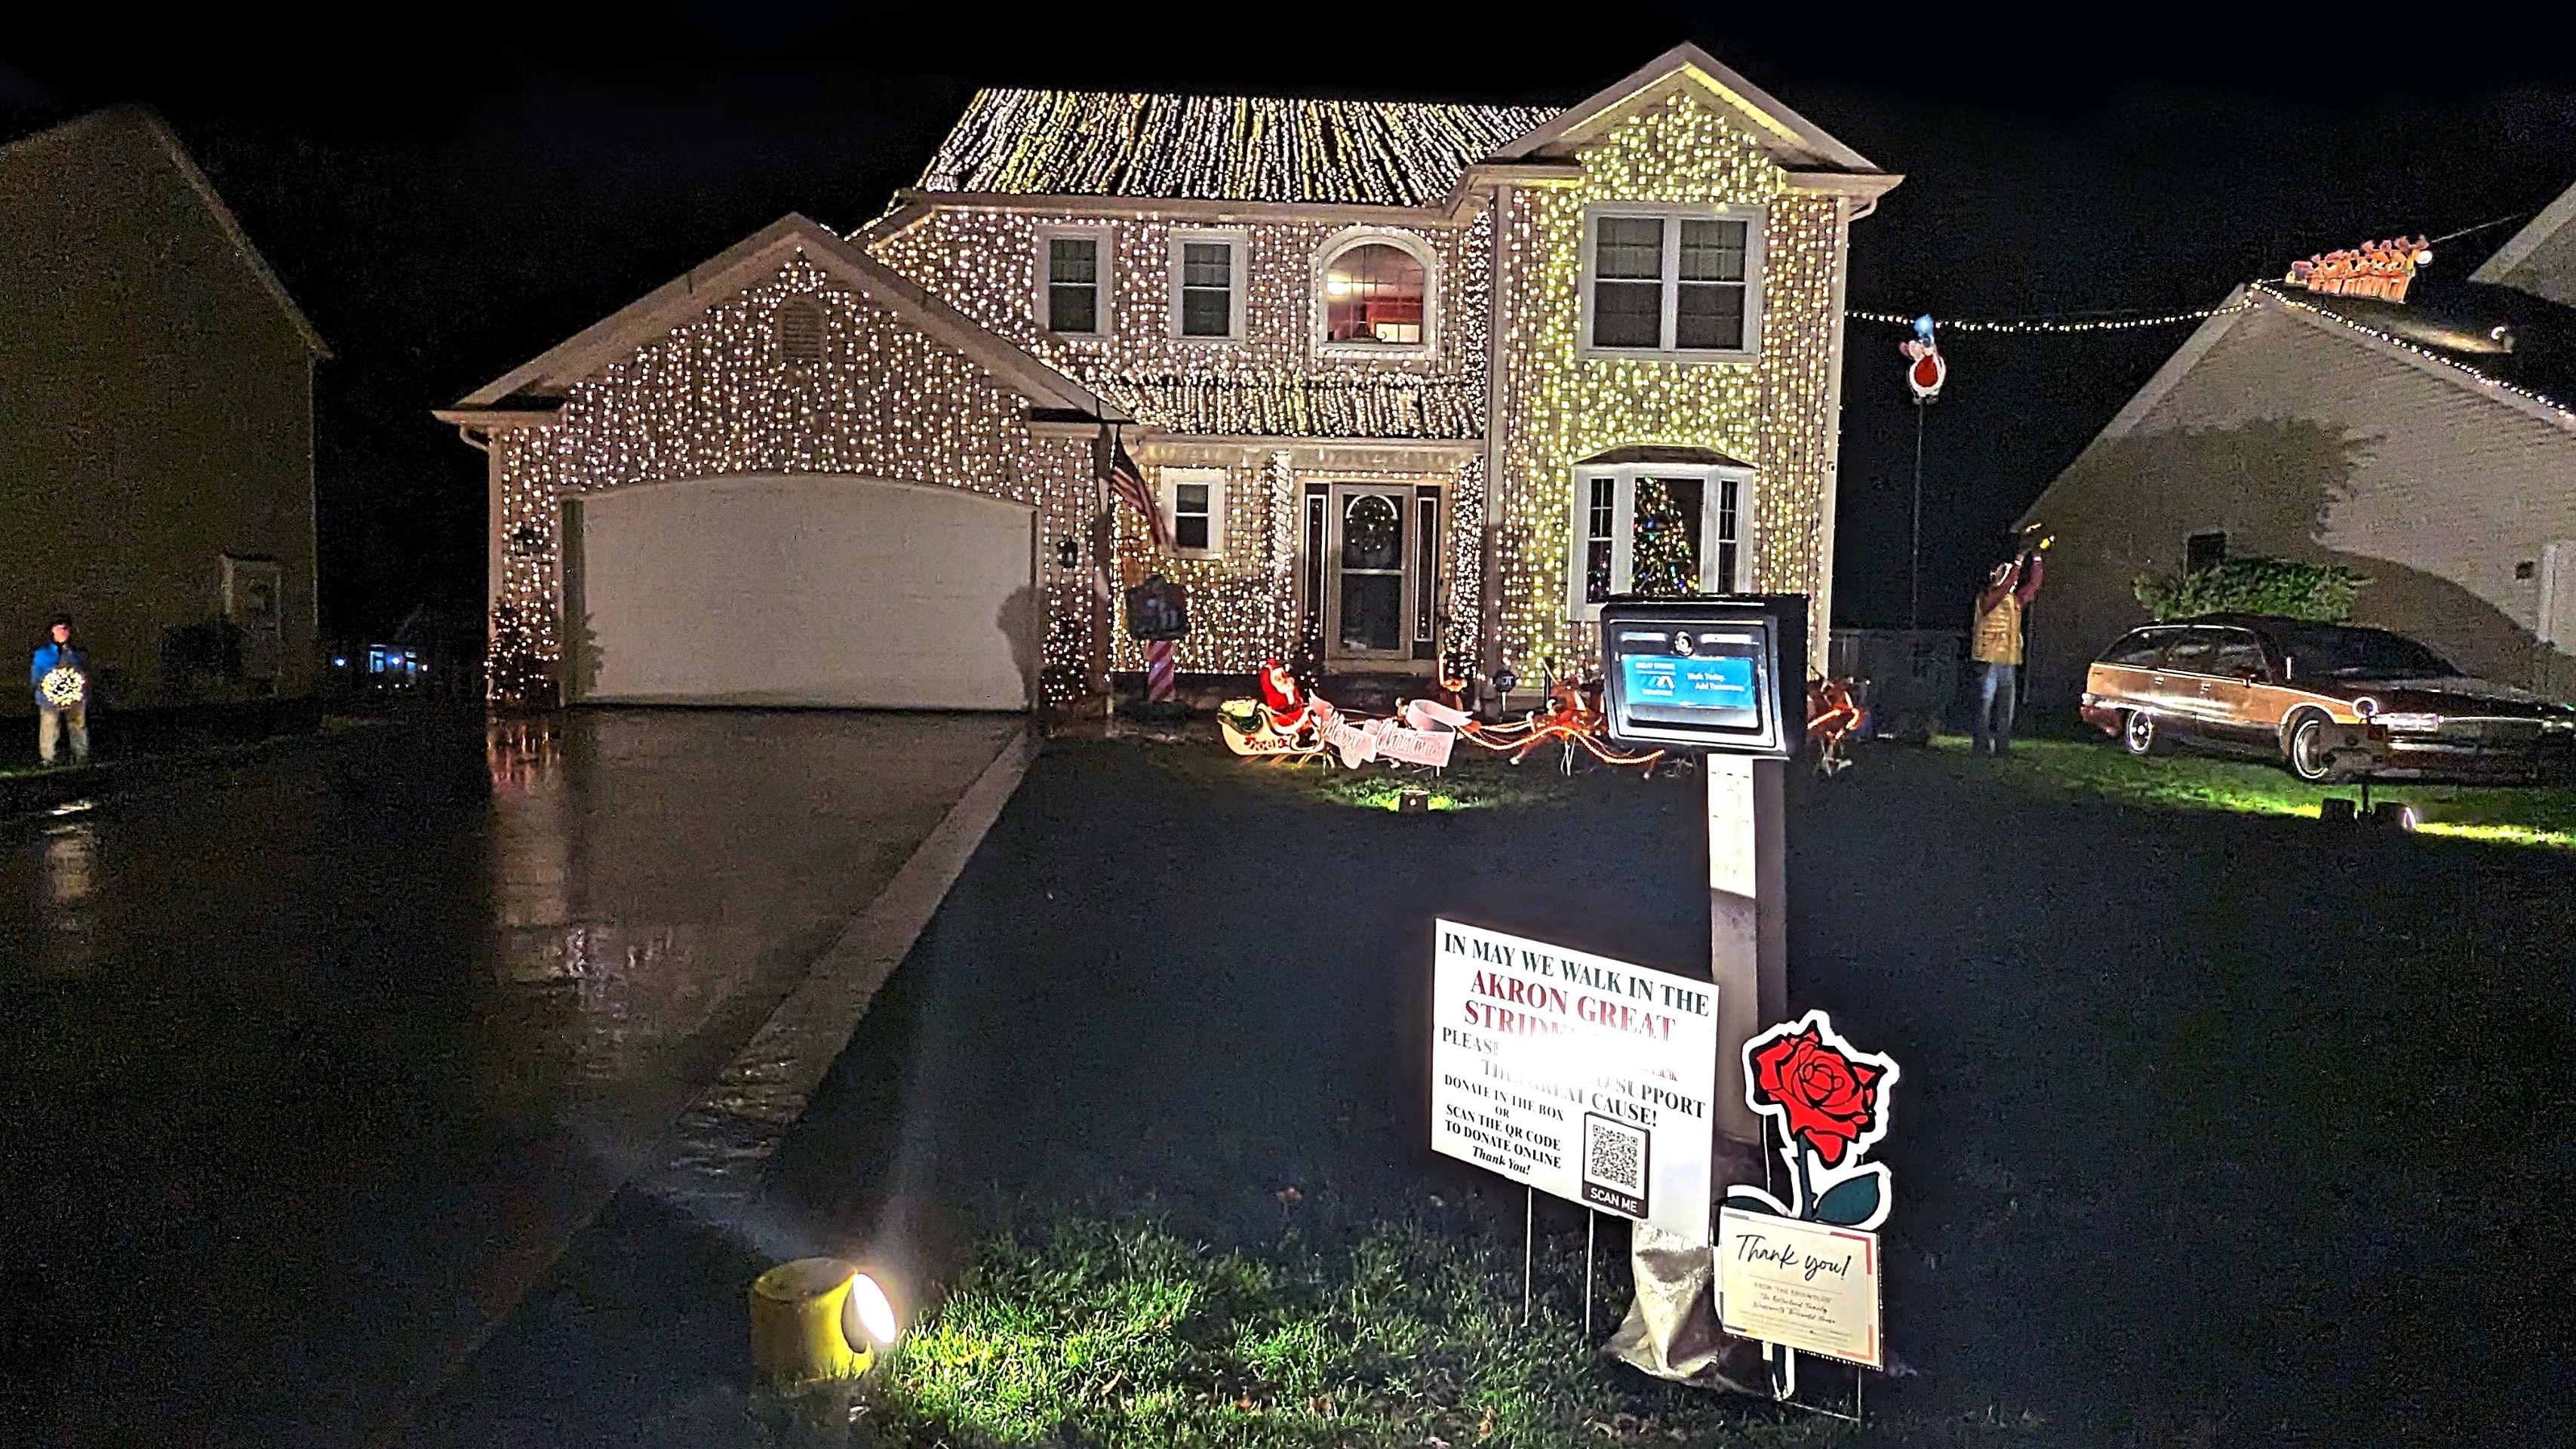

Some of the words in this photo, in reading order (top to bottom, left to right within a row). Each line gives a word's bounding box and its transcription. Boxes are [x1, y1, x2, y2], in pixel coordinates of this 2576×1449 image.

[1320, 711, 1366, 763] Merry
[1376, 718, 1446, 759] Christmas
[1444, 932, 1466, 955] IN
[1472, 939, 1516, 967] MAY
[1521, 950, 1554, 977] WE
[1560, 959, 1622, 994] WALK
[1628, 977, 1653, 1001] IN
[1660, 984, 1709, 1017] THE
[1471, 970, 1569, 1014] AKRON
[1577, 995, 1676, 1041] GREAT
[1444, 1074, 1490, 1098] DONATE
[1495, 1090, 1507, 1103] IN
[1511, 1094, 1535, 1112] THE
[1539, 1104, 1563, 1121] BOX
[1495, 1106, 1510, 1118] OR
[1591, 1093, 1657, 1127] CAUSE!
[1615, 1078, 1705, 1118] SUPPORT
[1445, 1119, 1461, 1134] TO
[1464, 1126, 1511, 1152] DONATE
[1514, 1143, 1561, 1169] ONLINE
[1446, 1104, 1475, 1122] SCAN
[1478, 1114, 1502, 1132] THE
[1505, 1124, 1523, 1139] QR
[1526, 1131, 1561, 1151] CODE
[1472, 1146, 1505, 1166] Thank
[1509, 1158, 1531, 1175] You!
[1590, 1187, 1619, 1207] SCAN
[1622, 1197, 1637, 1214] ME
[1736, 1234, 1799, 1269] Thank
[1804, 1255, 1852, 1281] you!
